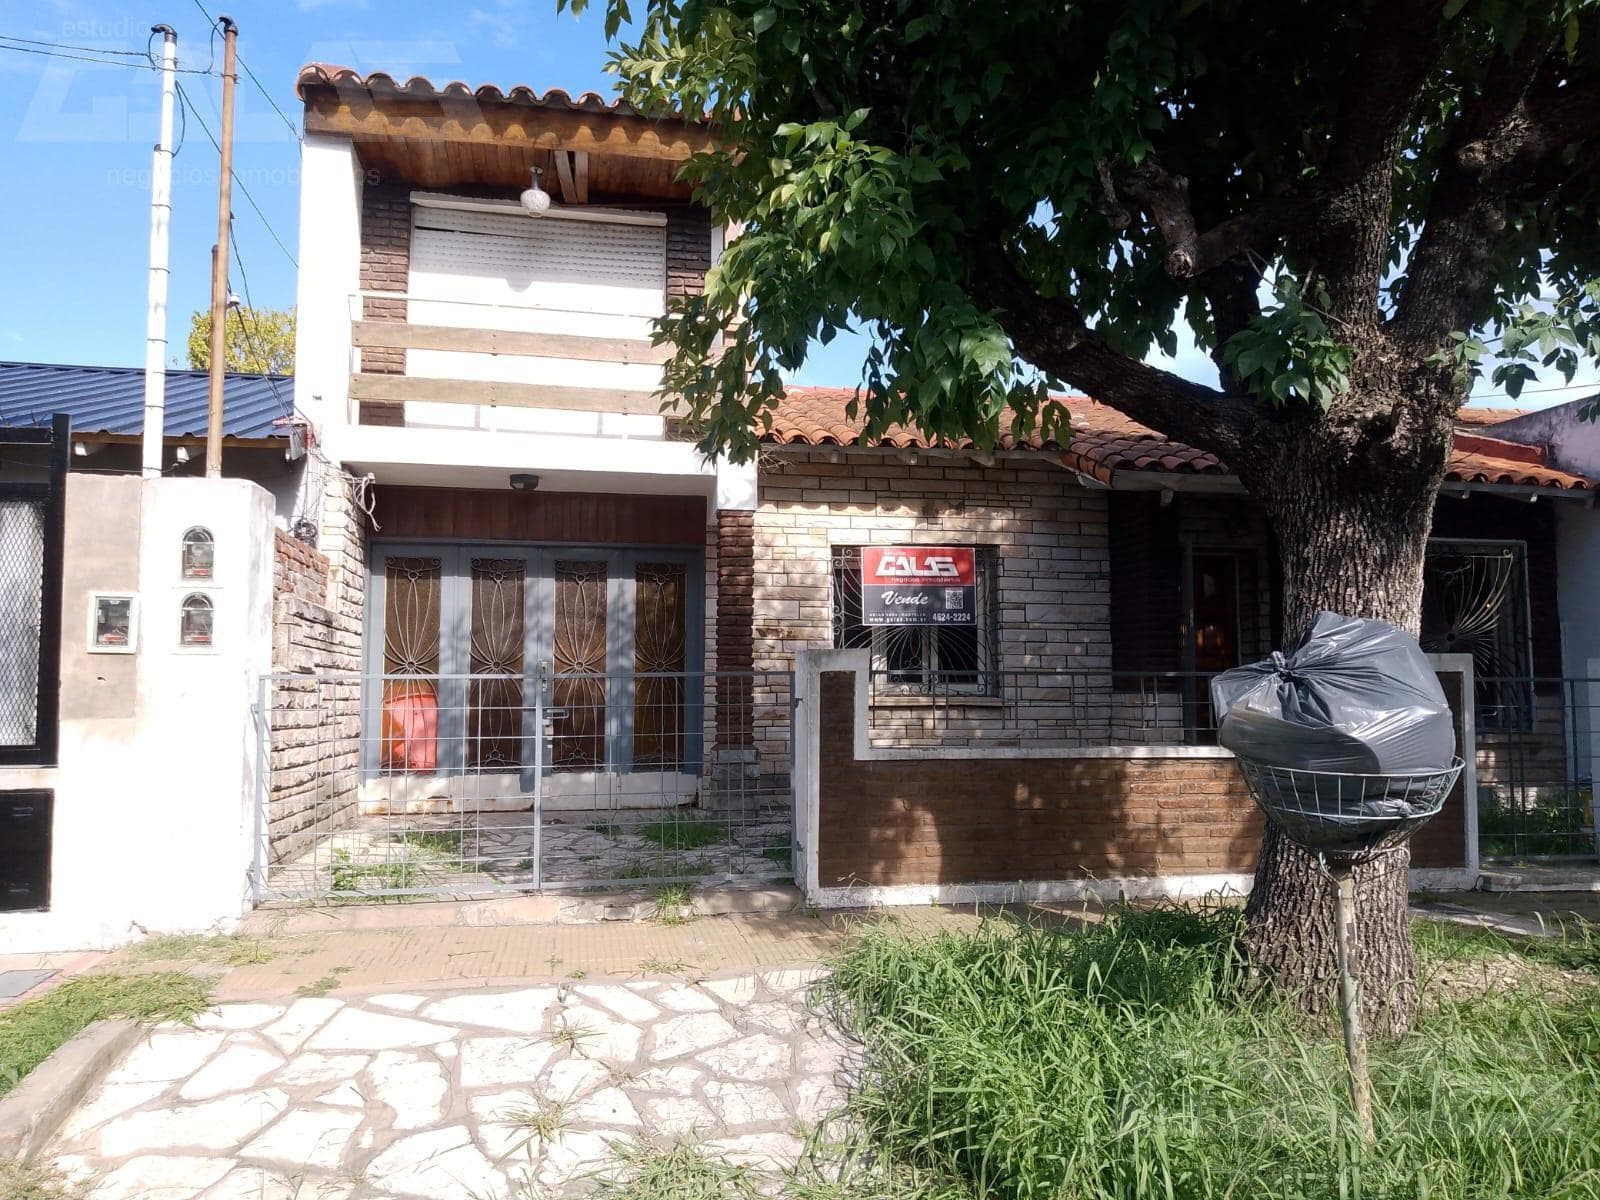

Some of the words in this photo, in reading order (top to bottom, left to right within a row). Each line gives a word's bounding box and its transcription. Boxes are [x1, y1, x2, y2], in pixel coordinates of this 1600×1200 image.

[875, 556, 959, 577] GALAS
[881, 590, 929, 606] Vende
[932, 612, 971, 622] 4624-2224
